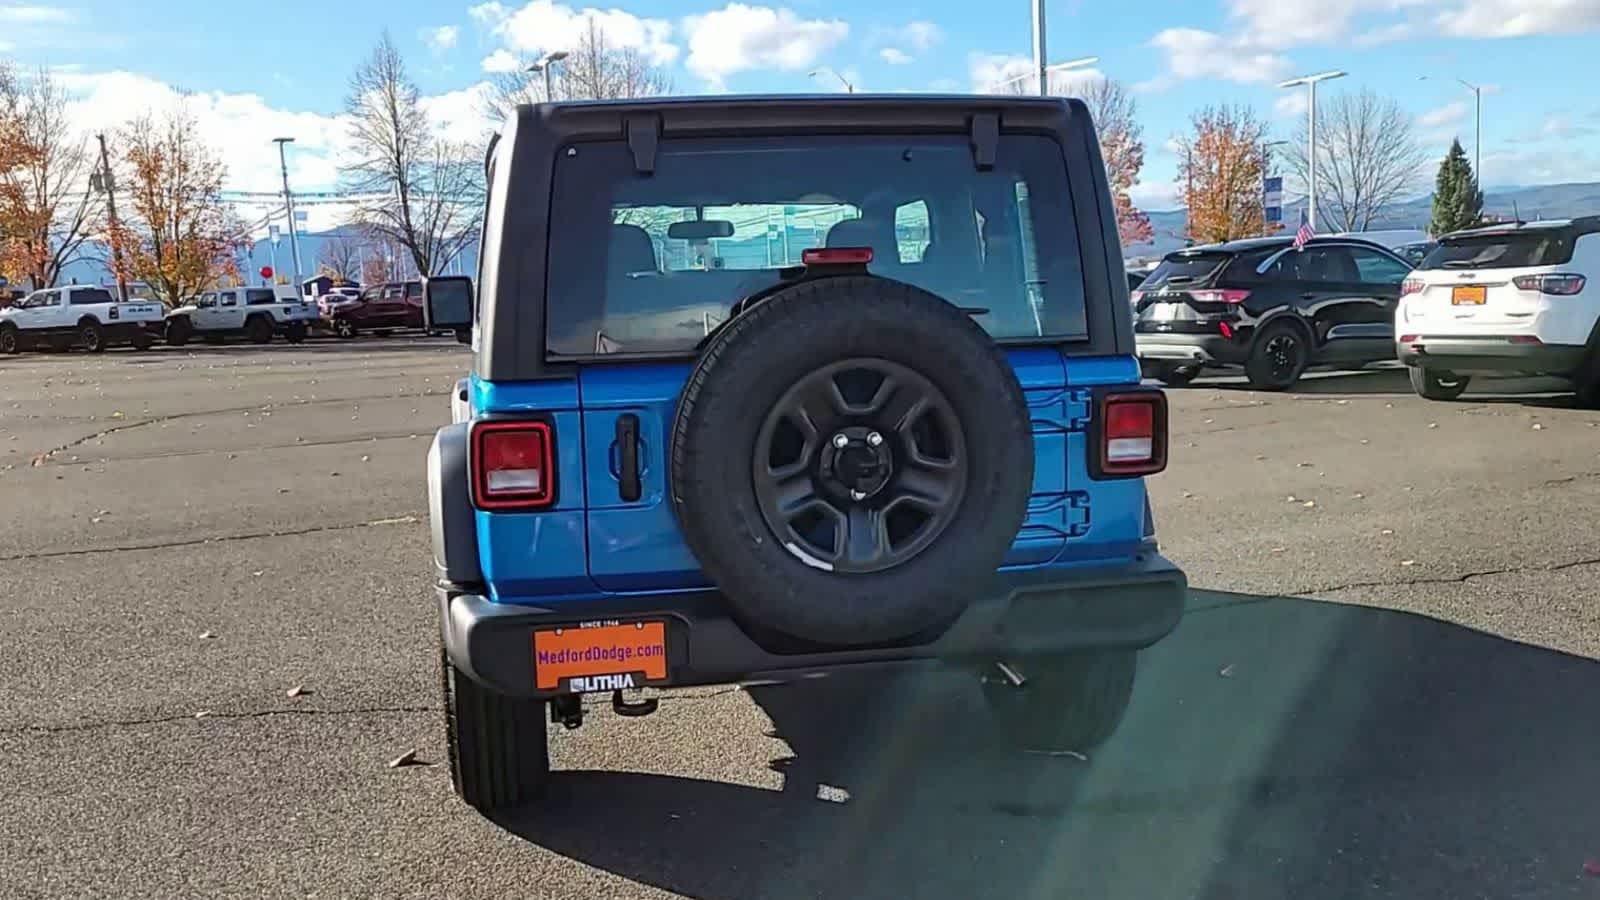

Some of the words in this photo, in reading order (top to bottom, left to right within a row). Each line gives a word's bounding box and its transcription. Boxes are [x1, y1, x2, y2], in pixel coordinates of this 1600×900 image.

[579, 621, 601, 629] SINCE
[538, 644, 664, 664] MedfordDodge.com
[585, 673, 635, 690] LITHIA
